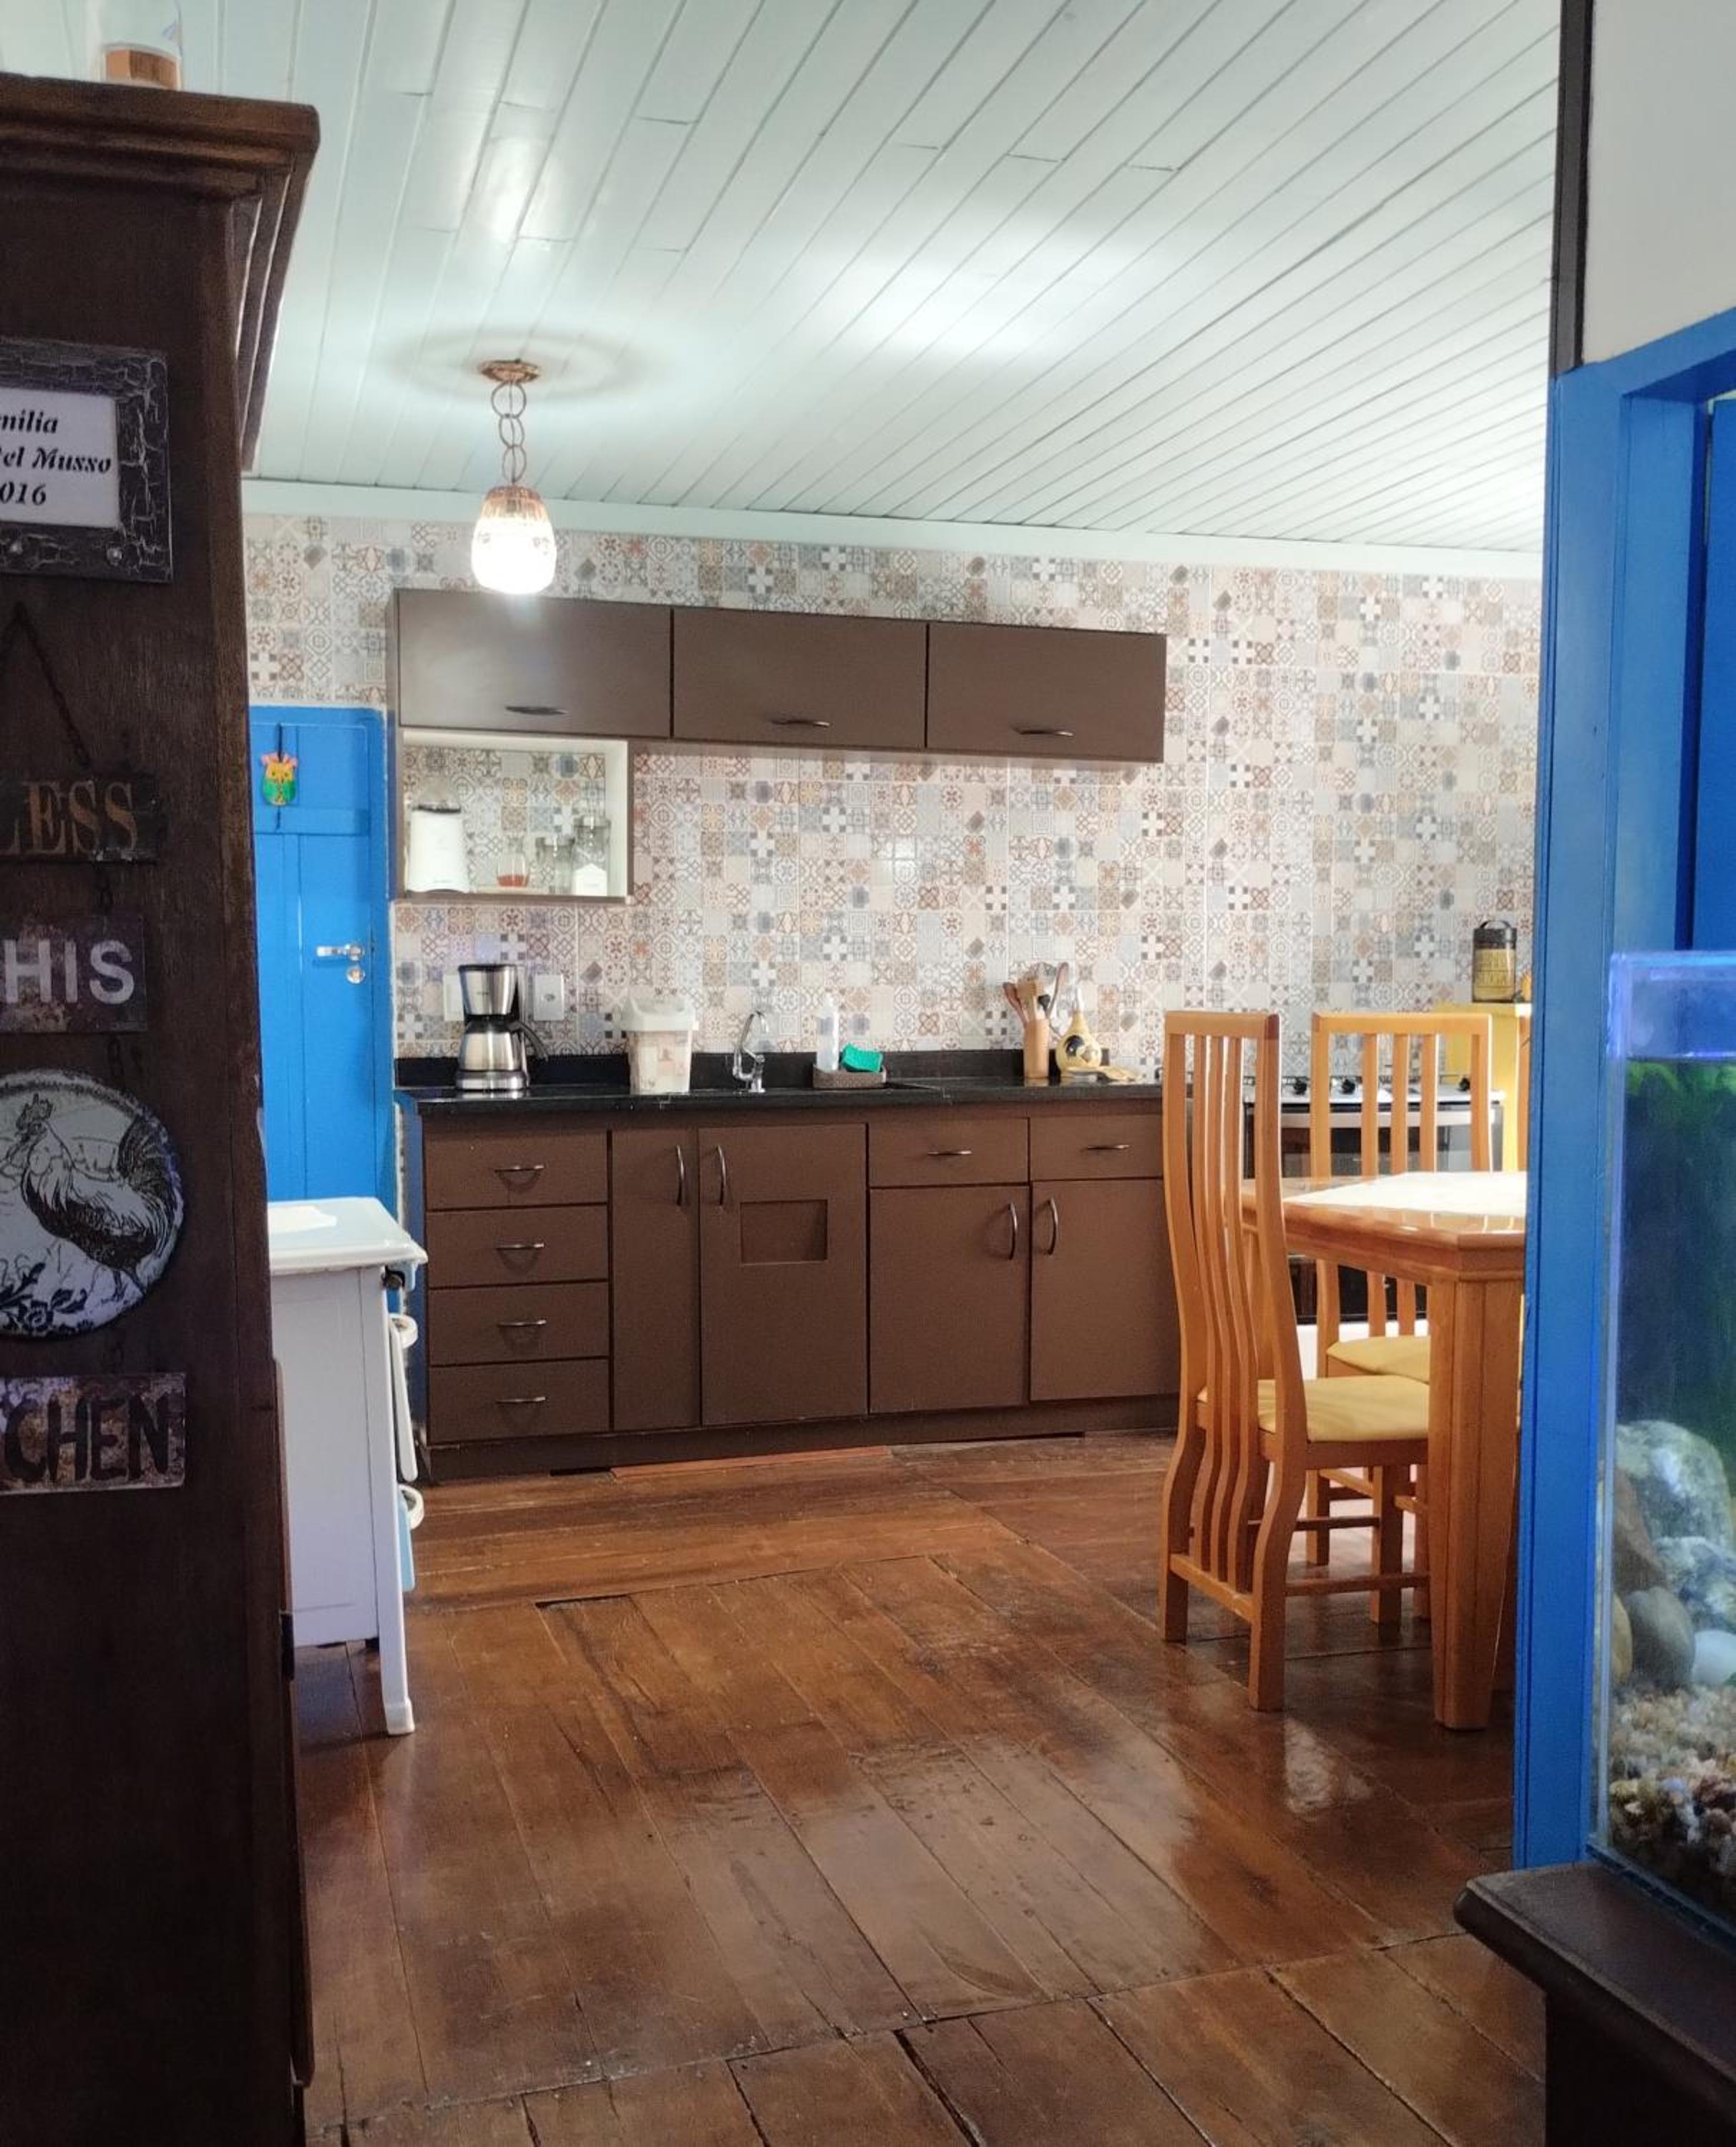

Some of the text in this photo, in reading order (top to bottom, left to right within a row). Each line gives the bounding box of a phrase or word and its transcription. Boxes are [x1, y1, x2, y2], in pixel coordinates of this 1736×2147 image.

[0, 446, 112, 473] el Musso
[0, 481, 47, 505] 016
[4, 939, 135, 1004] HIS
[0, 1393, 169, 1484] CHEN
